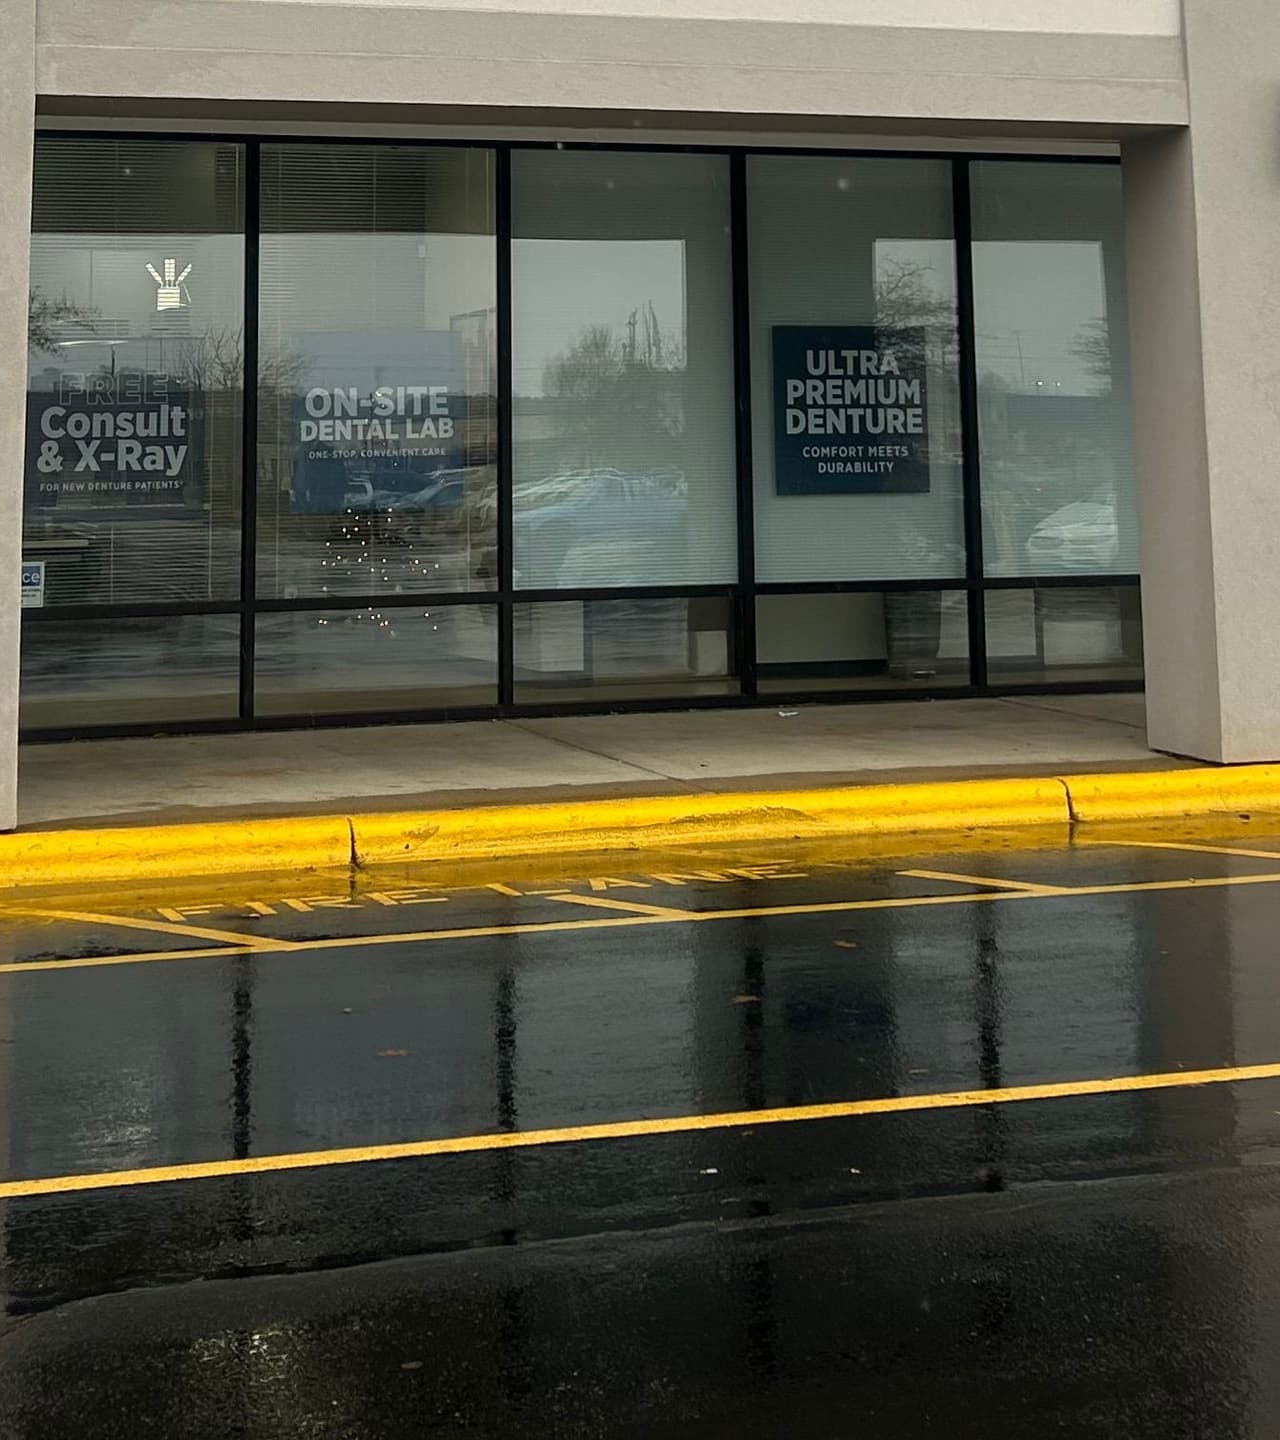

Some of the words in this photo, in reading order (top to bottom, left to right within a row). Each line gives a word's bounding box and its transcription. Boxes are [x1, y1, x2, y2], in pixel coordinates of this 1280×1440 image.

[805, 349, 900, 376] ULTRA
[59, 372, 169, 405] FREE
[786, 378, 921, 405] PREMIUM
[305, 386, 449, 418] ON-SITE
[40, 405, 186, 439] Consult
[300, 418, 399, 441] DENTAL
[406, 417, 455, 439] LAB
[785, 408, 923, 434] DENTURE
[36, 440, 64, 473] &
[74, 439, 188, 476] X-Ray
[360, 448, 419, 458] CONVENIENT
[422, 448, 447, 456] CARE
[802, 446, 863, 458] COMFORT
[868, 445, 909, 457] MEETS
[818, 462, 894, 473] DURABILITY
[40, 482, 60, 492] FOR
[63, 482, 86, 491] NEW
[88, 481, 132, 491] DENTURE
